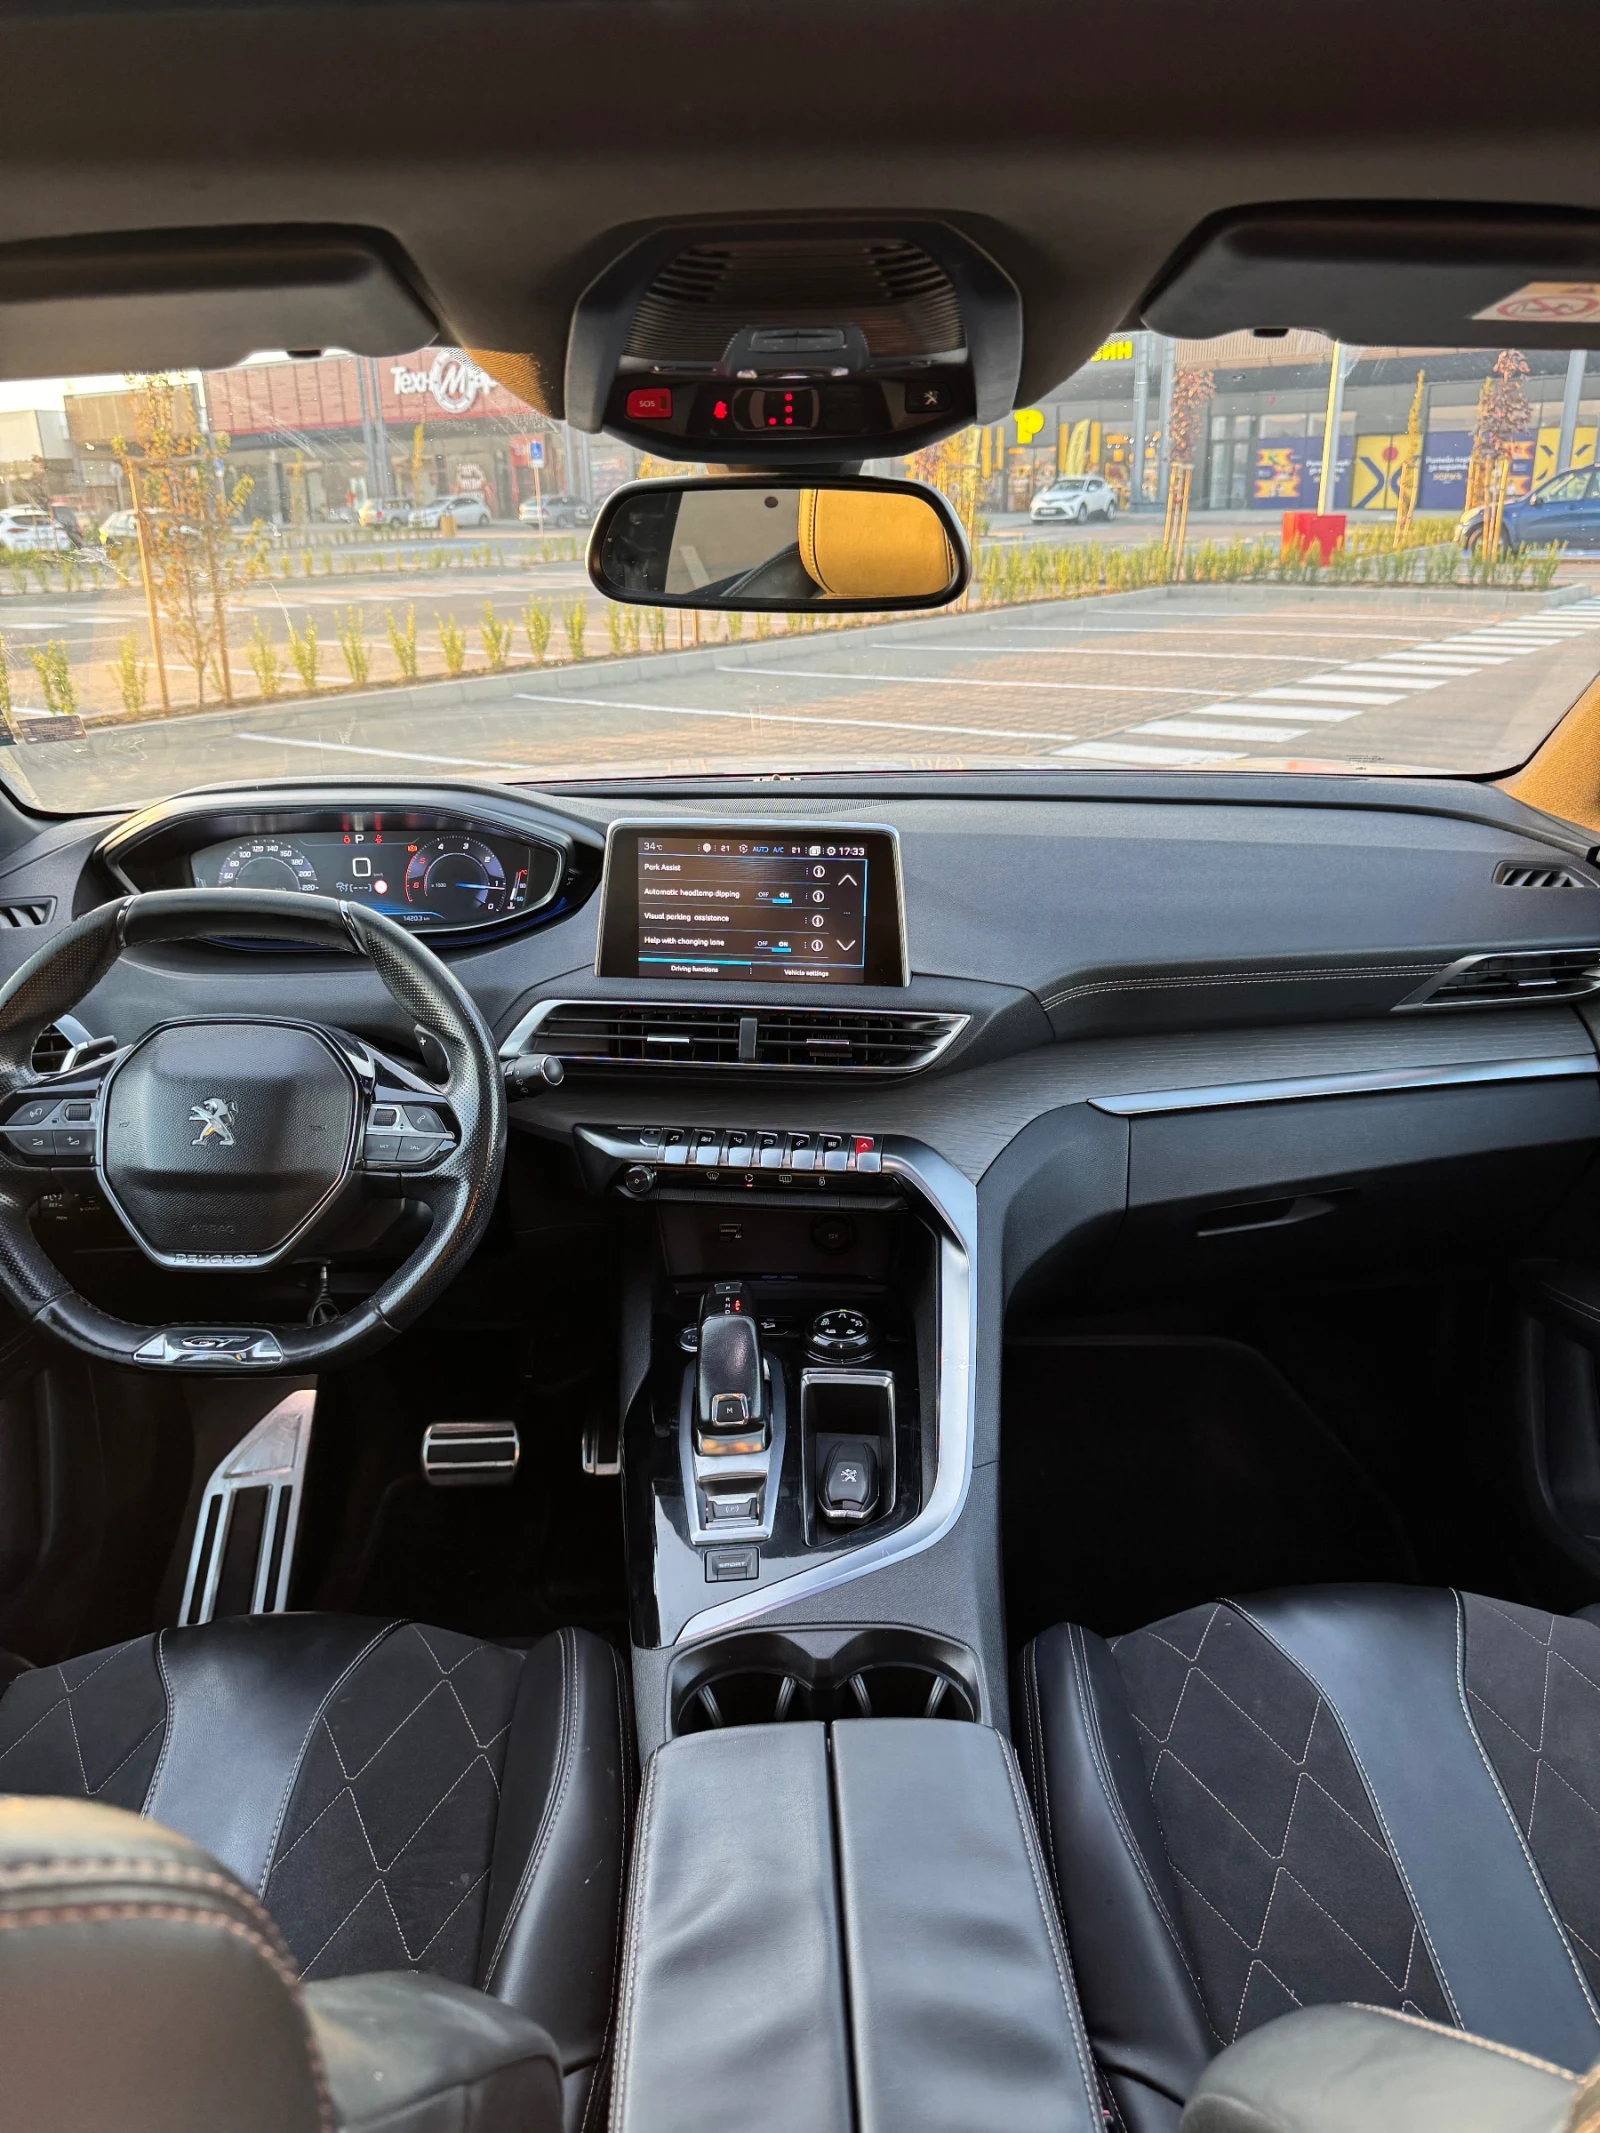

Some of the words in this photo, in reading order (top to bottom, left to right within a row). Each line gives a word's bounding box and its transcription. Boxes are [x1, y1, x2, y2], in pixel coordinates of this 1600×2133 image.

[639, 400, 656, 408] SOS
[355, 834, 364, 844] P
[643, 842, 656, 851] 34
[838, 847, 865, 856] 17:33
[352, 857, 371, 877] 0
[644, 863, 660, 871] Park
[660, 863, 681, 871] Assist
[644, 888, 679, 896] Automatic
[680, 889, 714, 898] headlamp
[714, 890, 740, 899] dipping
[644, 912, 665, 920] Visual
[666, 913, 691, 922] parking
[694, 914, 730, 922] assistance
[644, 936, 661, 945] Help
[677, 937, 709, 947] changing
[709, 938, 725, 946] lane
[671, 965, 691, 973] Driving
[692, 965, 719, 973] functions
[805, 969, 829, 978] settings
[173, 1253, 258, 1264] PEUGEOT
[181, 1335, 250, 1348] GT
